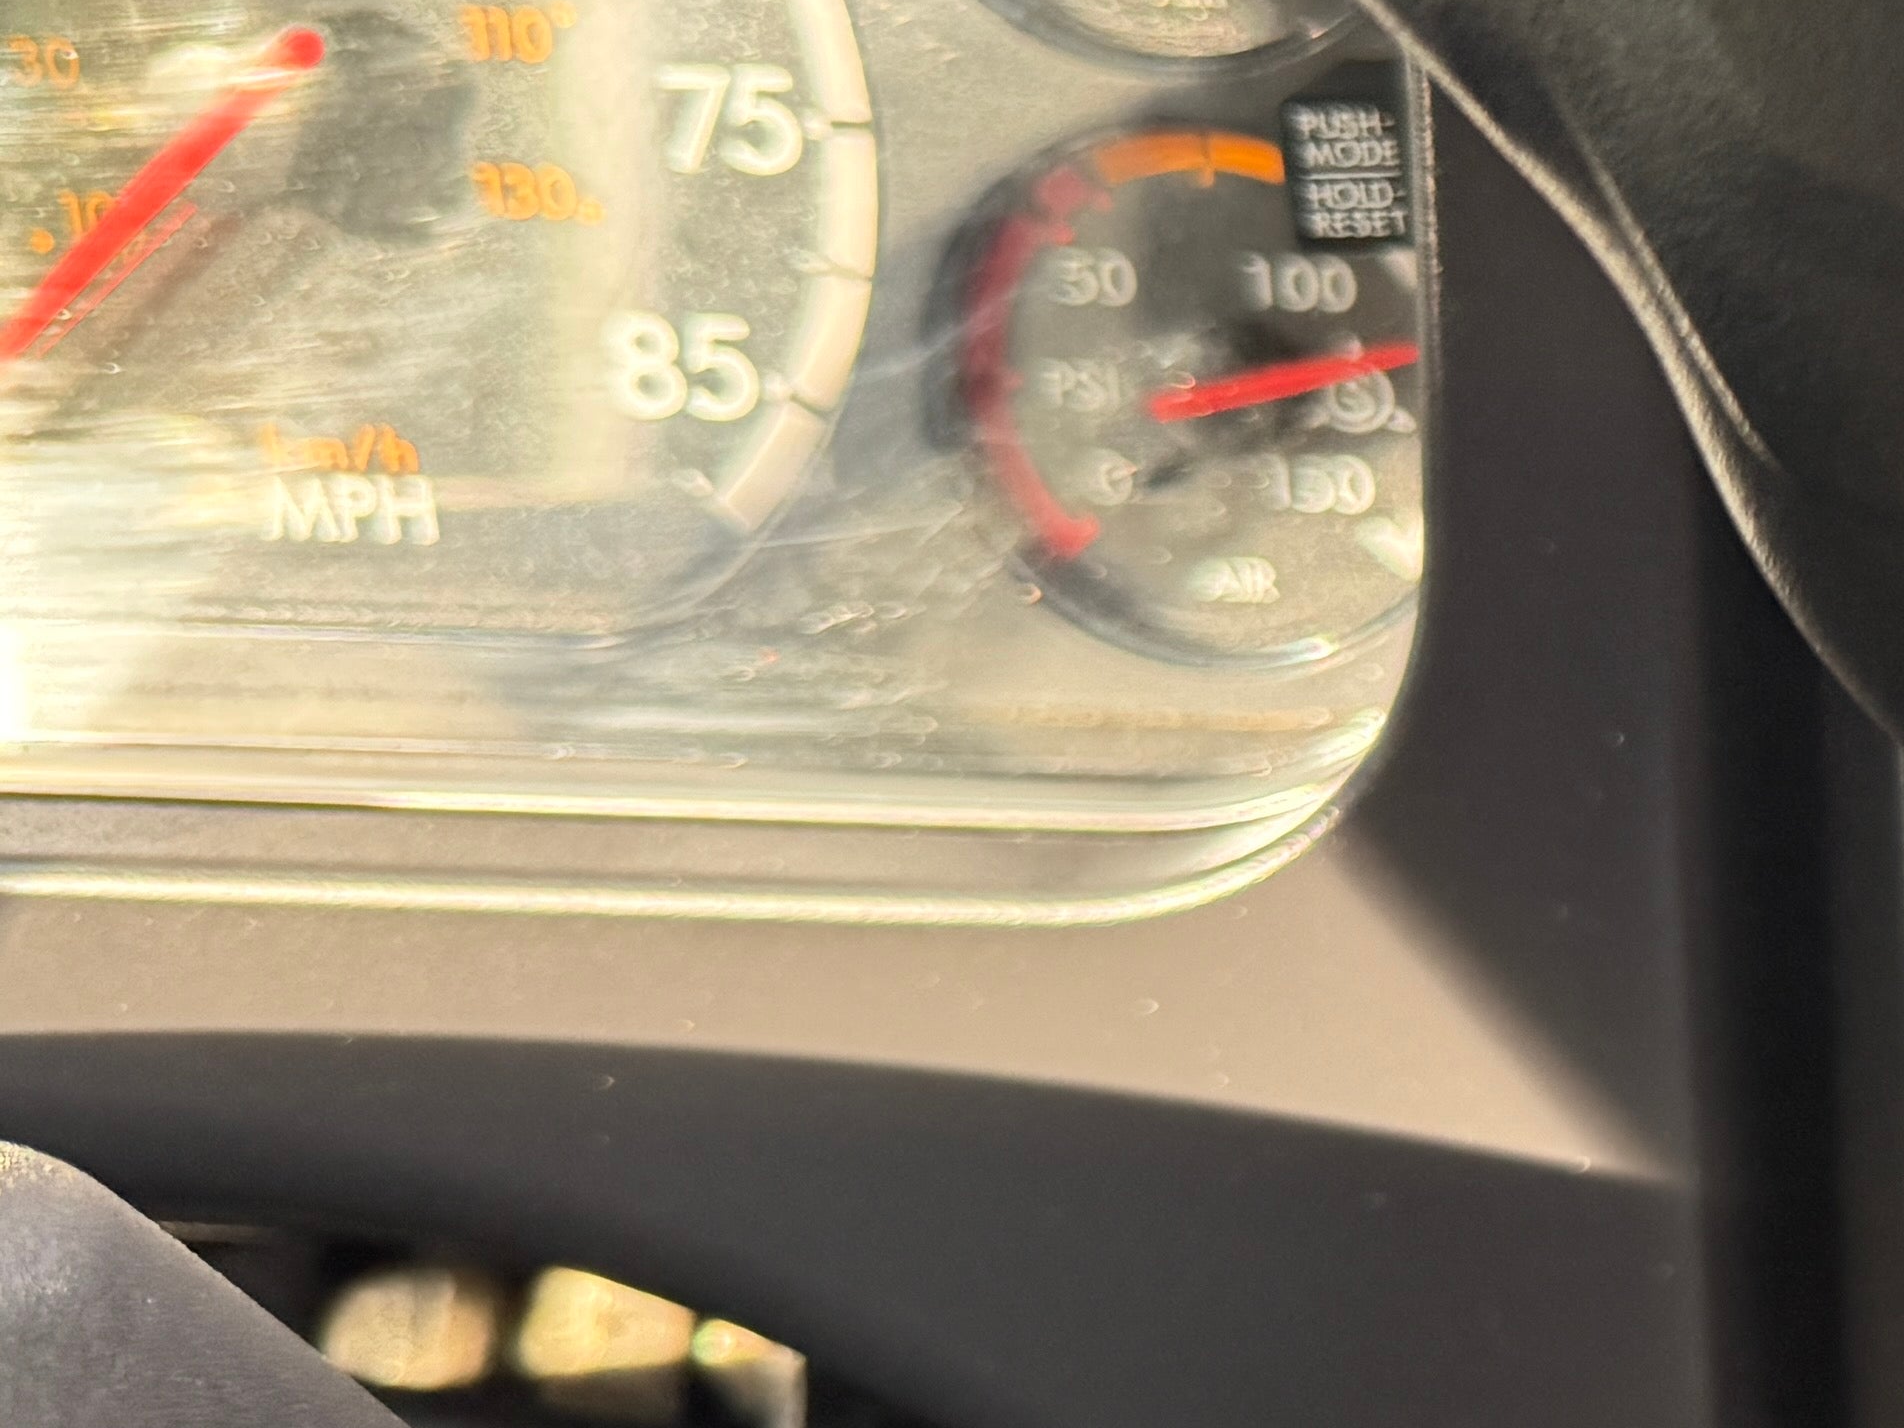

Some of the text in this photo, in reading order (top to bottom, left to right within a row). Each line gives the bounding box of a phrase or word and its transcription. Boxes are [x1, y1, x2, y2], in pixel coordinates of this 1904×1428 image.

[6, 34, 80, 90] 30
[459, 4, 555, 66] 110
[657, 62, 803, 176] 75
[1303, 140, 1400, 169] MODE
[474, 161, 579, 222] 130
[1309, 211, 1408, 239] RESET
[1050, 248, 1137, 308] 50
[1243, 253, 1358, 313] 100
[607, 310, 759, 421] 85
[258, 424, 420, 475] km/h
[266, 473, 442, 545] MPH
